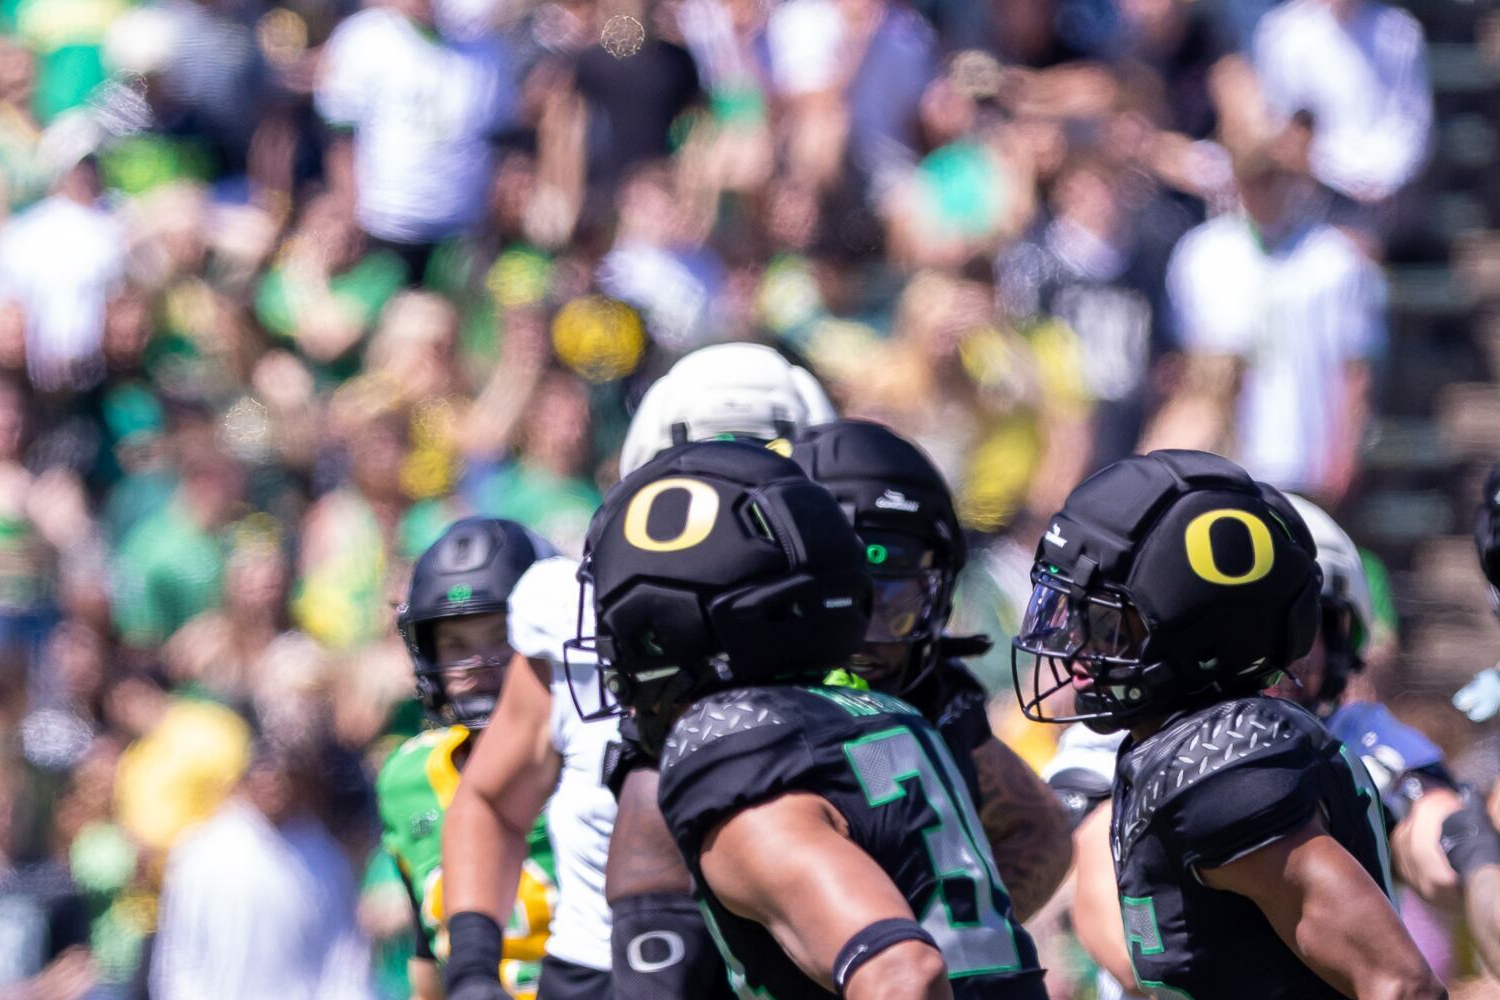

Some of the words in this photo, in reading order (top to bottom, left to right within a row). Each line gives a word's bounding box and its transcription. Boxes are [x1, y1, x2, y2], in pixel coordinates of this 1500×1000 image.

[624, 477, 720, 552] O
[1185, 508, 1275, 585] O
[626, 929, 686, 974] O
